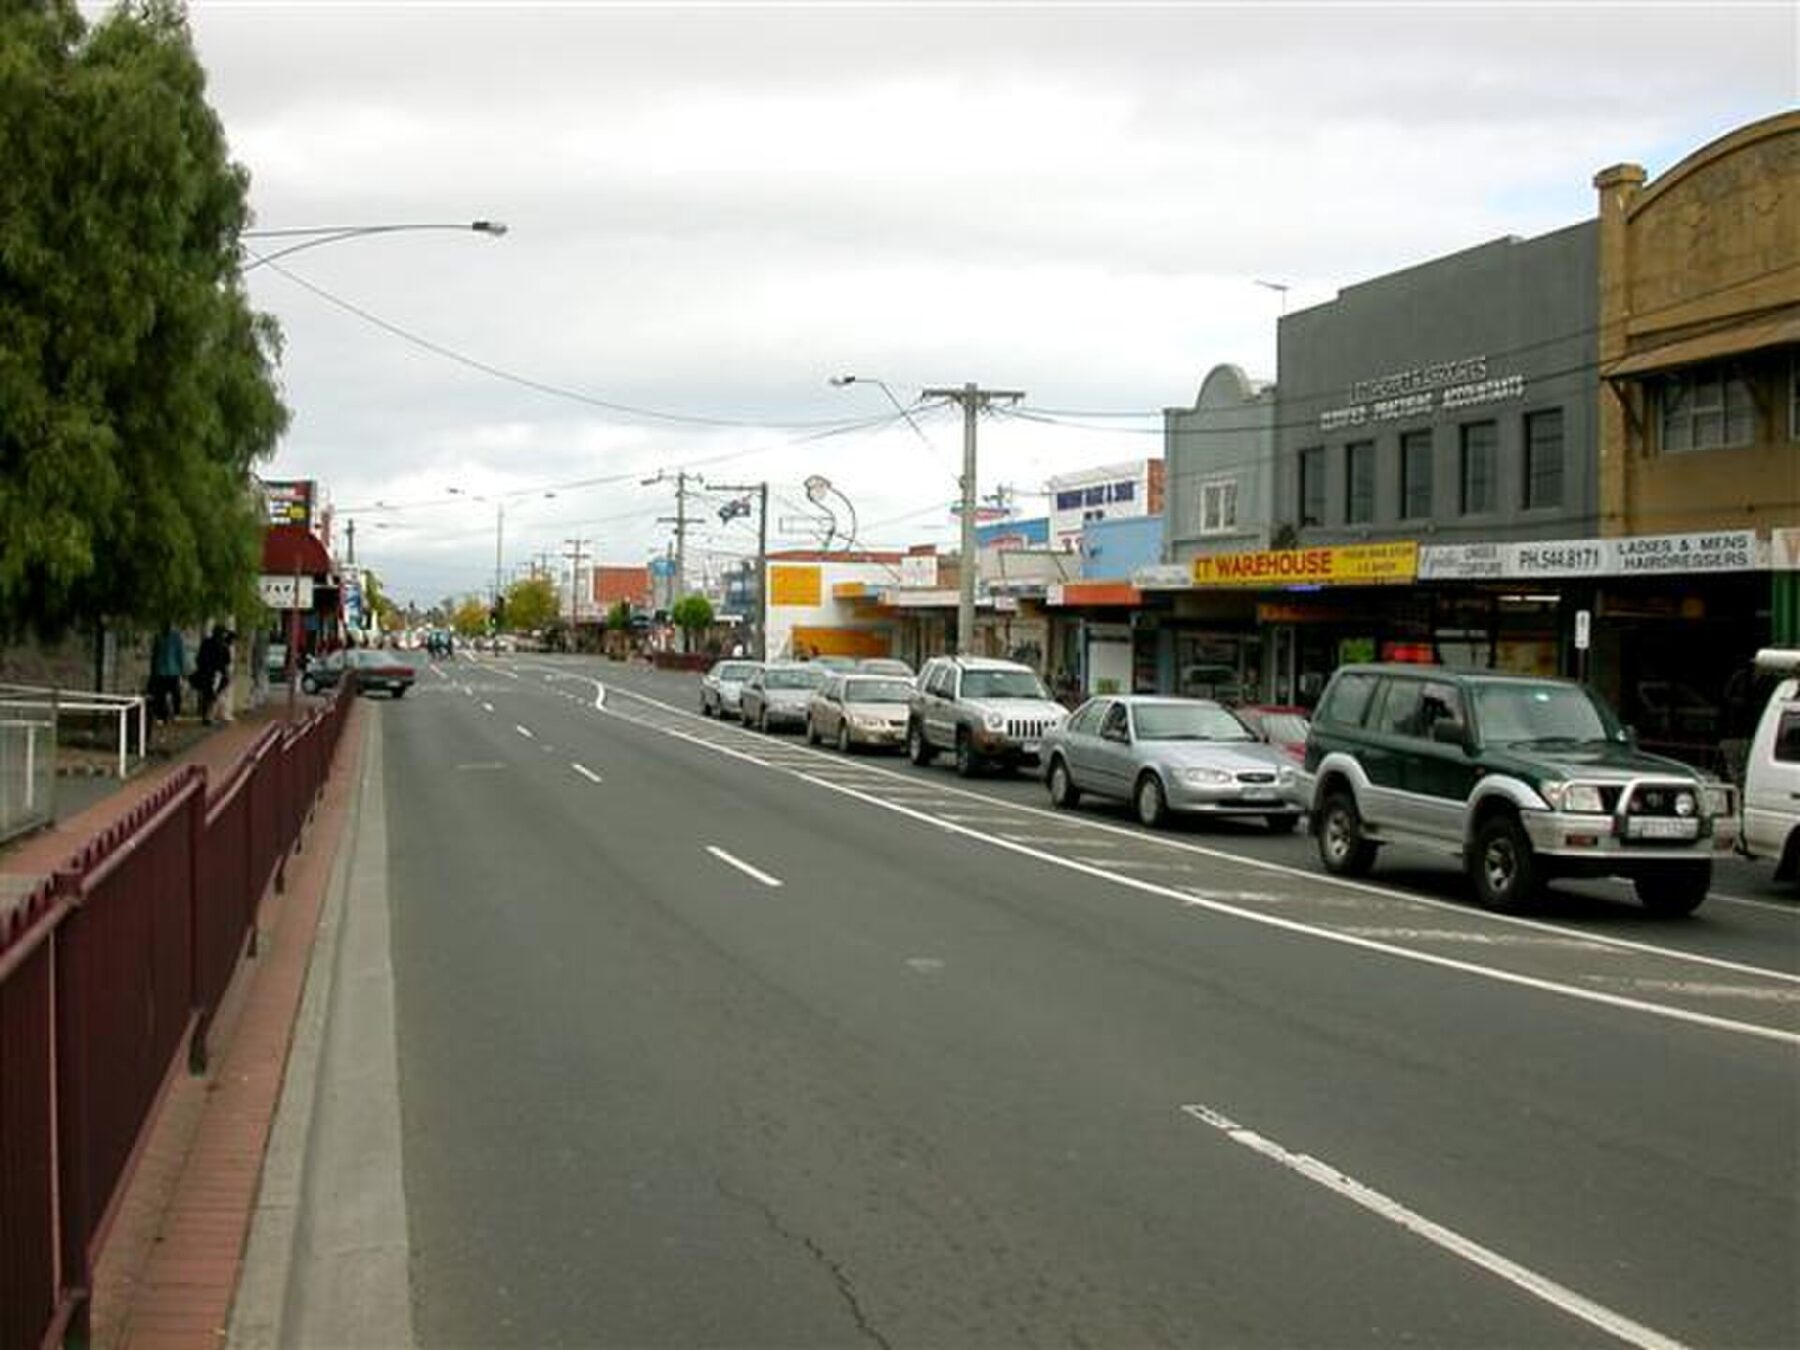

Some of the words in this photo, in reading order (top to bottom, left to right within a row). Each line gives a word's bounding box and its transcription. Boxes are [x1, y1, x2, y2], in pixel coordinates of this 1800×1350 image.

[1618, 539, 1672, 555] LADIES
[1678, 538, 1690, 551] &
[1700, 535, 1749, 550] MENS
[1215, 551, 1333, 577] WAREHOUSE
[1623, 552, 1749, 570] HAIRDRESSERS
